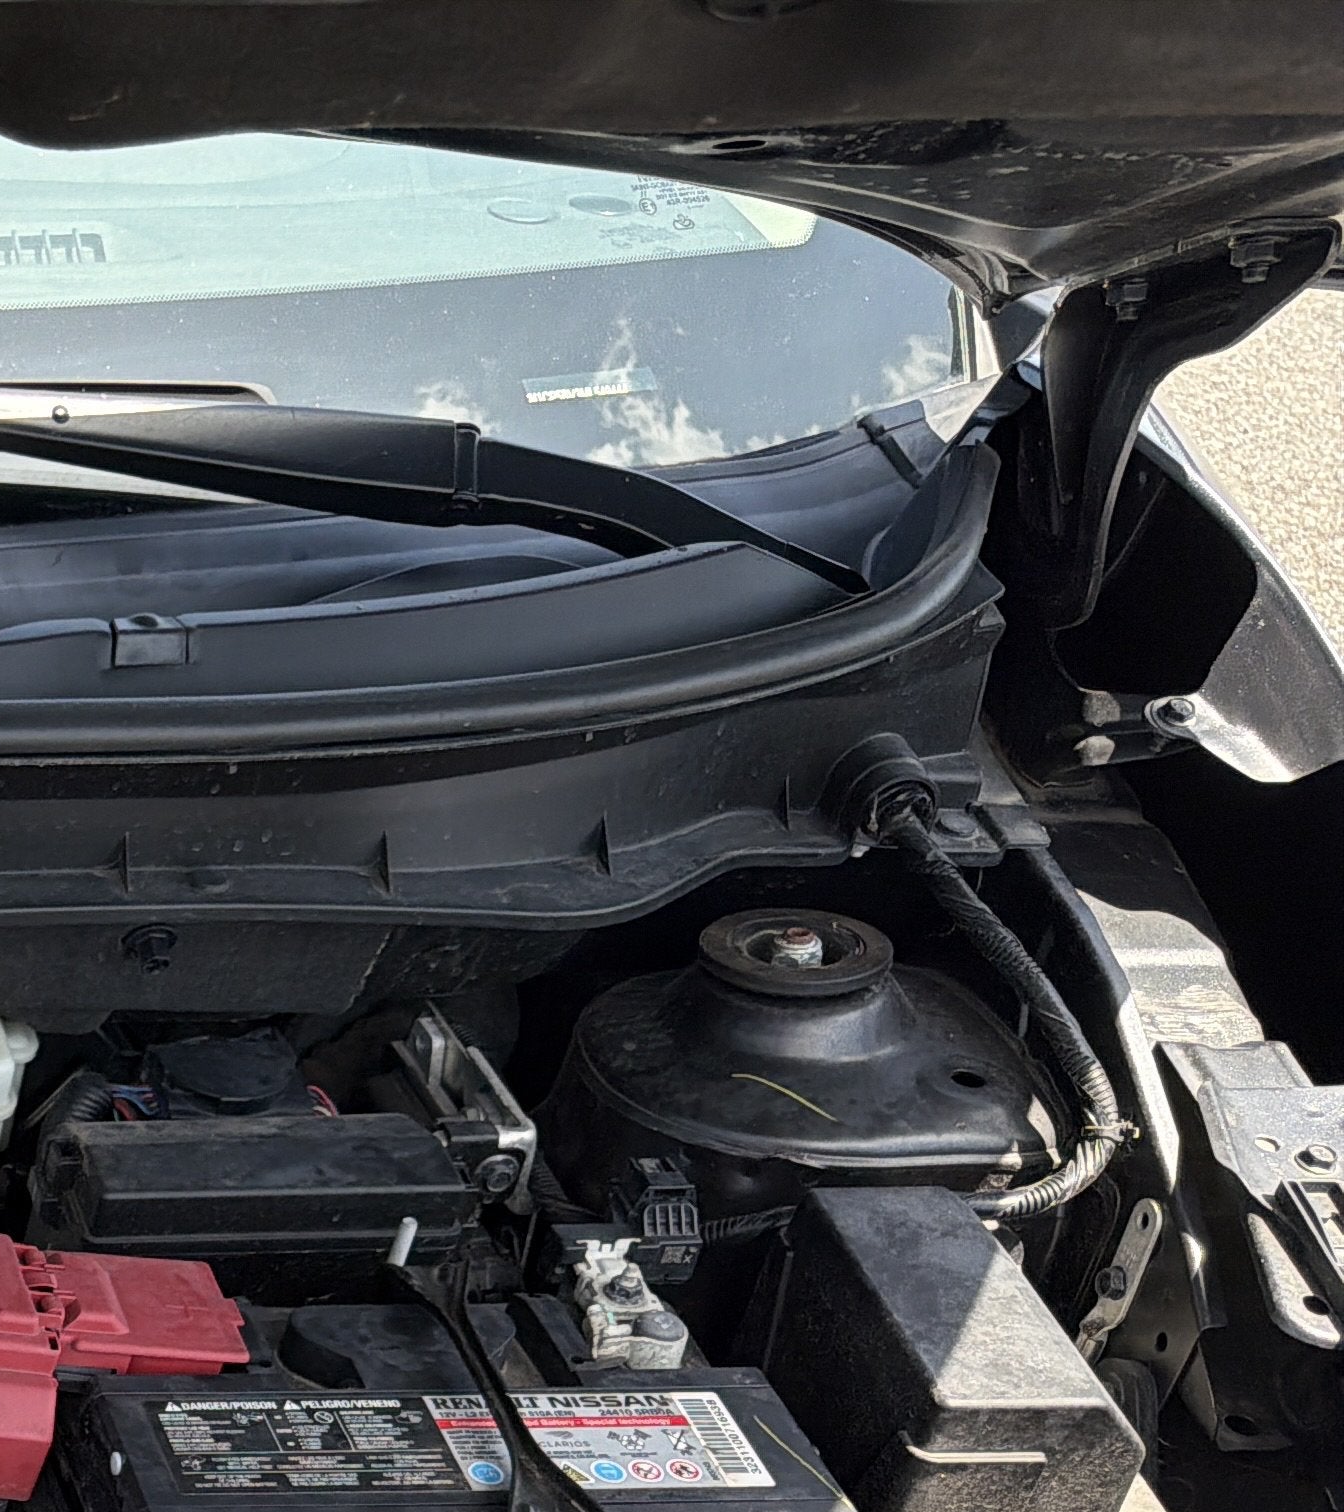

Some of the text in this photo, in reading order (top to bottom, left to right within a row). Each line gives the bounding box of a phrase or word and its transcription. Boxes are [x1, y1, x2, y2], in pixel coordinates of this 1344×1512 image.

[300, 1400, 401, 1409] PELIGRO/VENENO
[543, 1395, 673, 1408] NISSAN
[180, 1402, 278, 1411] DANGER/POISON
